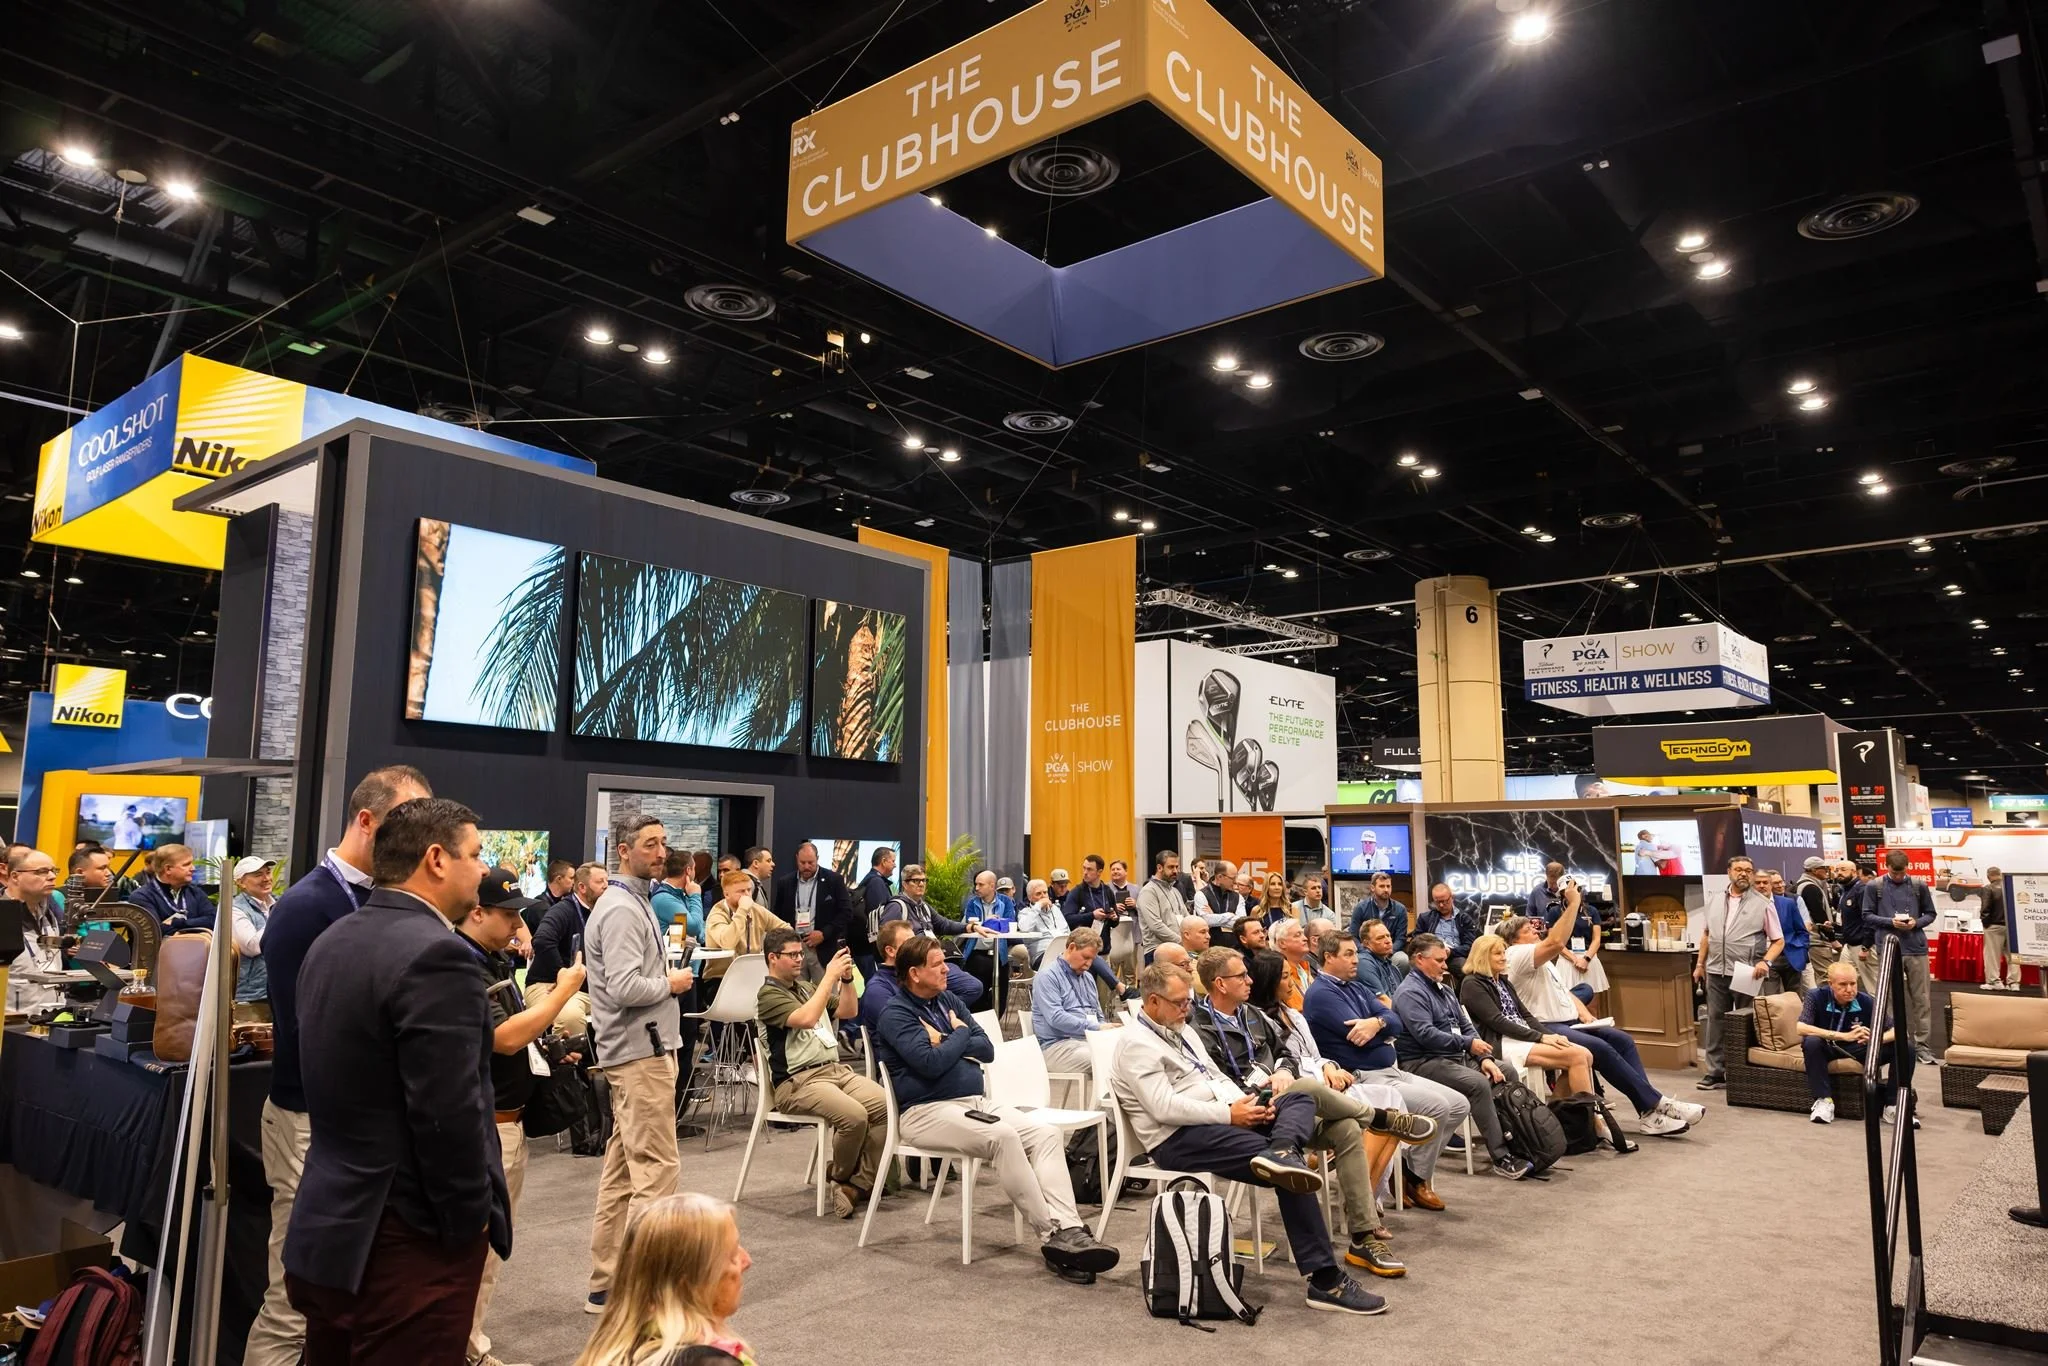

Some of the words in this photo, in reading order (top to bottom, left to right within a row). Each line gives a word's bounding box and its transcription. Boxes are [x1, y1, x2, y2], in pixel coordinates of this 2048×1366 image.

[1063, 5, 1091, 24] PGA
[906, 54, 981, 118] THE
[1250, 65, 1302, 138] THE
[802, 39, 1122, 218] CLUBHOUSE
[793, 130, 817, 157] RX
[1166, 50, 1375, 253] CLUBHOUSE
[78, 393, 168, 467] COOLSHOT
[174, 436, 261, 475] Nik
[31, 504, 63, 535] Nikon
[1465, 605, 1479, 624] 6
[1572, 648, 1610, 661] PGA
[1622, 641, 1675, 659] SHOW
[1531, 680, 1581, 697] FITNESS,
[1584, 676, 1628, 693] HEALTH
[1631, 677, 1641, 689] &
[1644, 670, 1712, 689] WELLNESS
[1071, 703, 1090, 713] THE
[1269, 695, 1305, 710] ELYTE
[56, 706, 120, 725] Nikon
[1045, 715, 1121, 732] CLUBHOUSE
[1269, 712, 1284, 723] THE
[1285, 714, 1313, 727] FUTURE
[1314, 719, 1325, 728] OF
[1269, 723, 1325, 739] PERFORMANCE
[1269, 734, 1277, 744] IS
[1278, 735, 1301, 746] ELYTE
[1384, 747, 1416, 756] FULL
[1045, 762, 1071, 773] PGA
[1077, 760, 1113, 773] SHOW
[1504, 855, 1539, 871] THE
[1914, 862, 1930, 870] FOR
